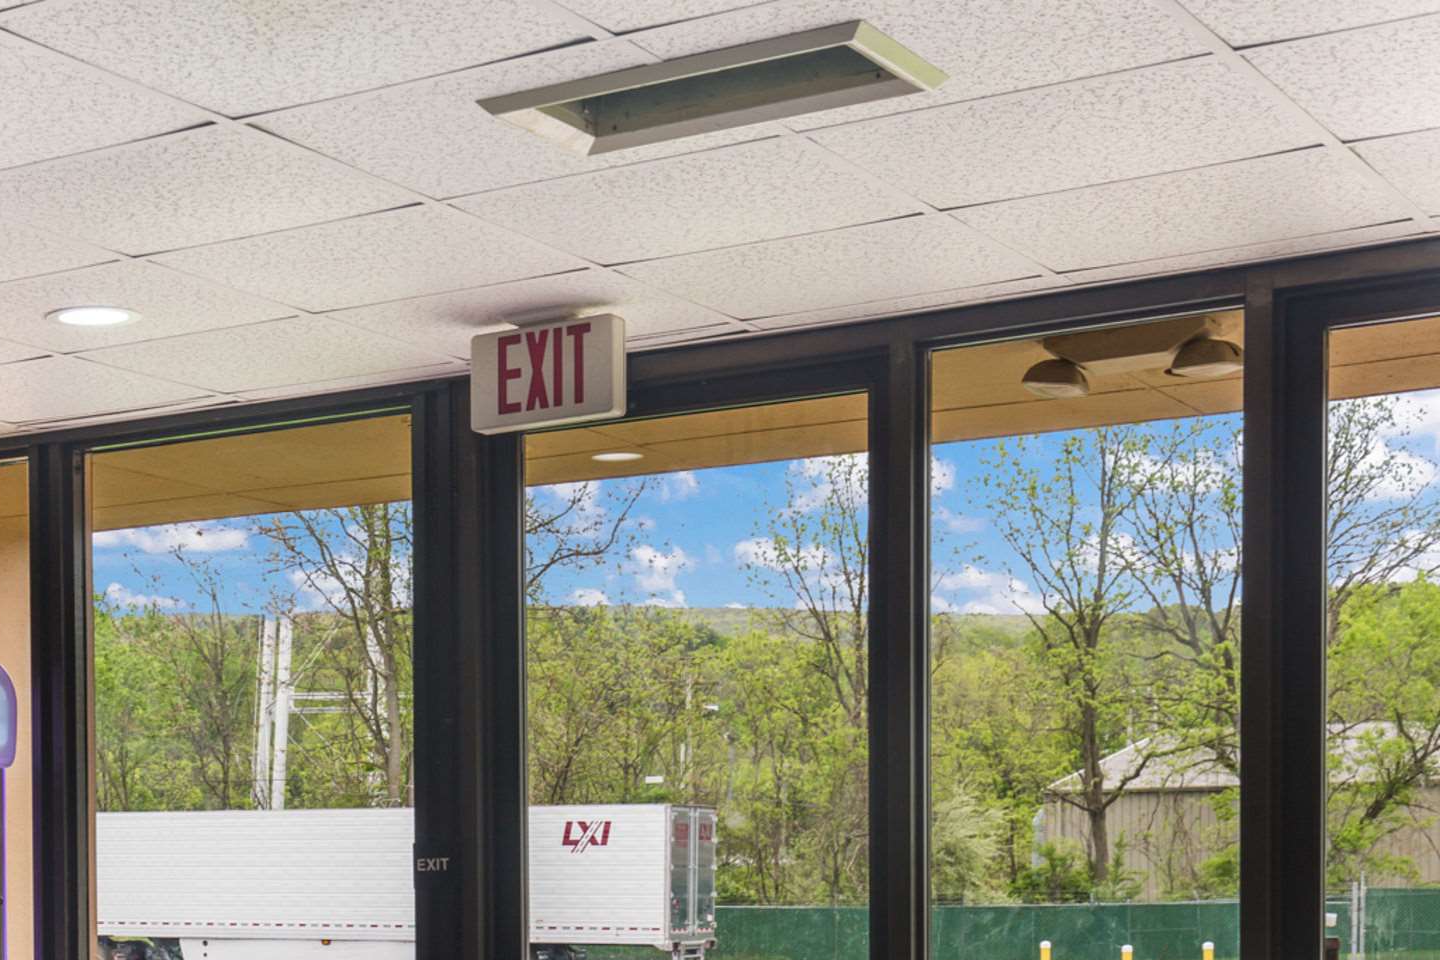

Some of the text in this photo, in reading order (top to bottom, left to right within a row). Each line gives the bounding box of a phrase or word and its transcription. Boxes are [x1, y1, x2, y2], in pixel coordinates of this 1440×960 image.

[497, 322, 591, 415] EXIT
[562, 820, 612, 852] LXI
[416, 857, 450, 872] EXIT
